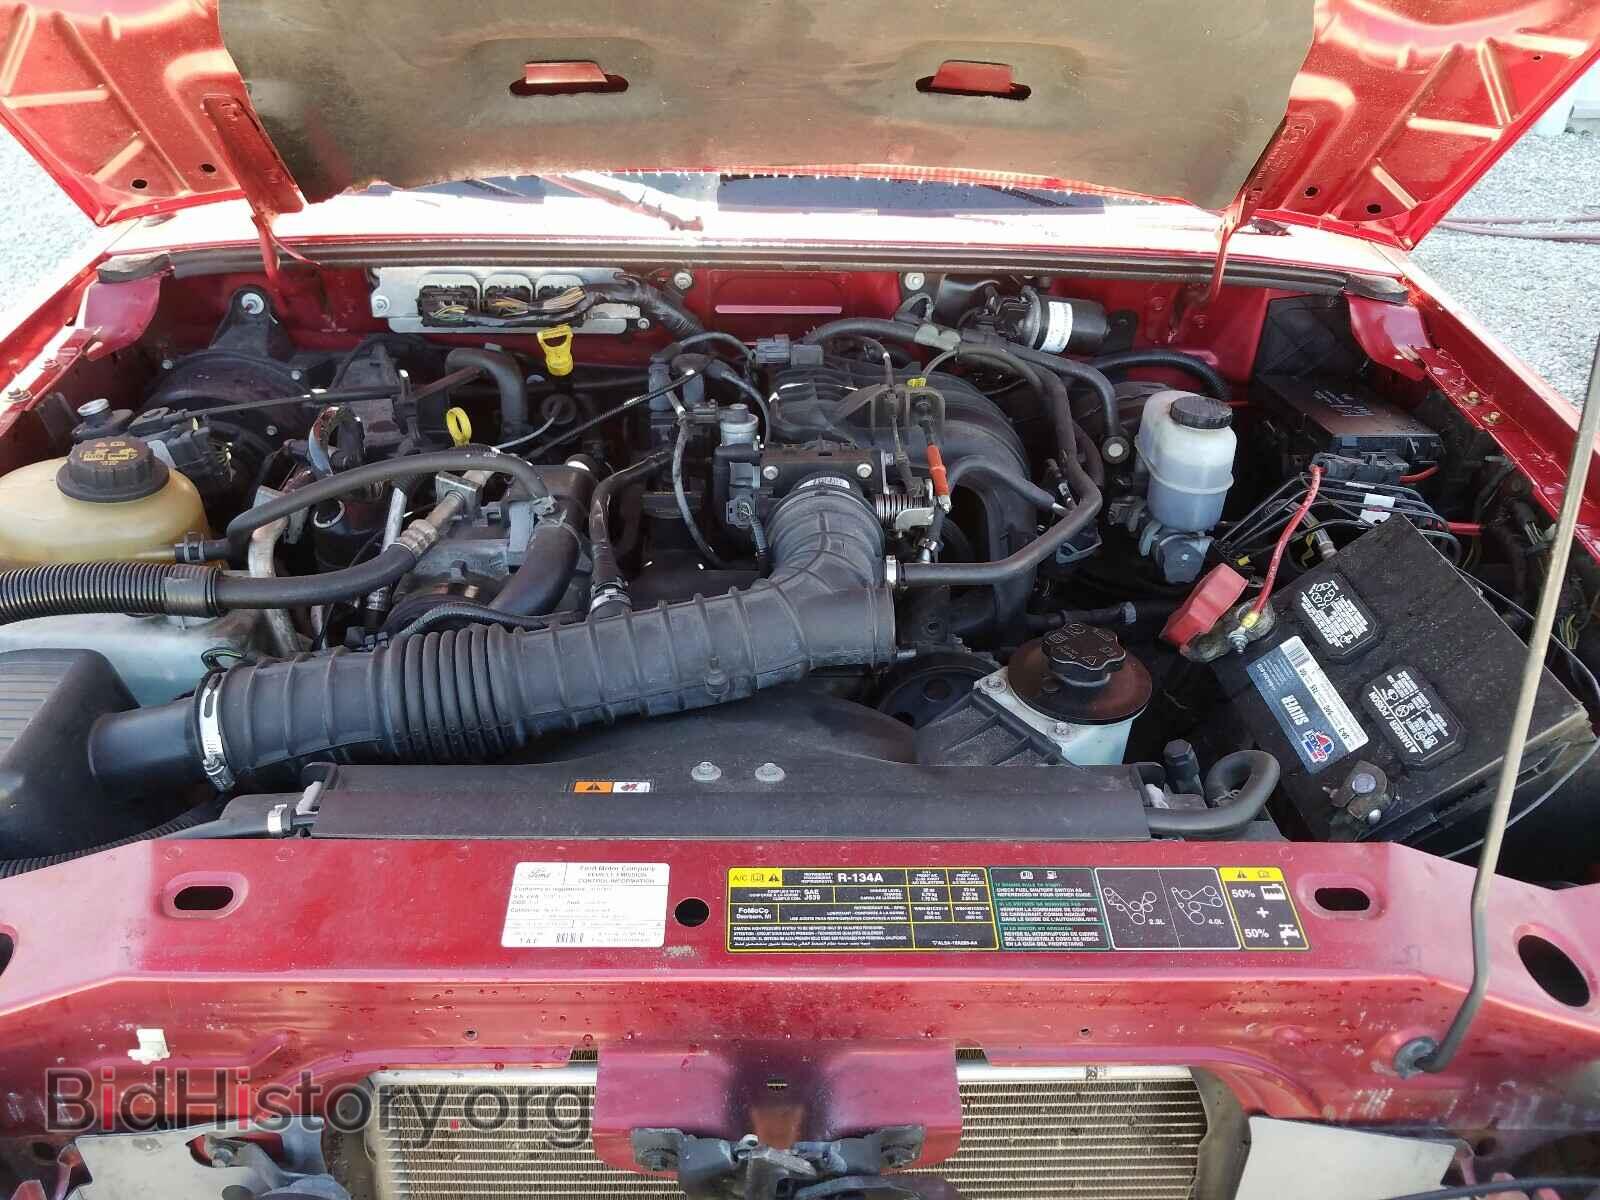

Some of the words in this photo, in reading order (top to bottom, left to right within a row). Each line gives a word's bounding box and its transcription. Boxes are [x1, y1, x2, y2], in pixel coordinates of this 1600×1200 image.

[1281, 694, 1310, 726] SILVER
[1368, 692, 1391, 716] POISON
[1389, 720, 1414, 748] DANGER
[838, 873, 884, 882] R-134A
[1231, 889, 1256, 898] 50%
[1245, 929, 1270, 938] 50%
